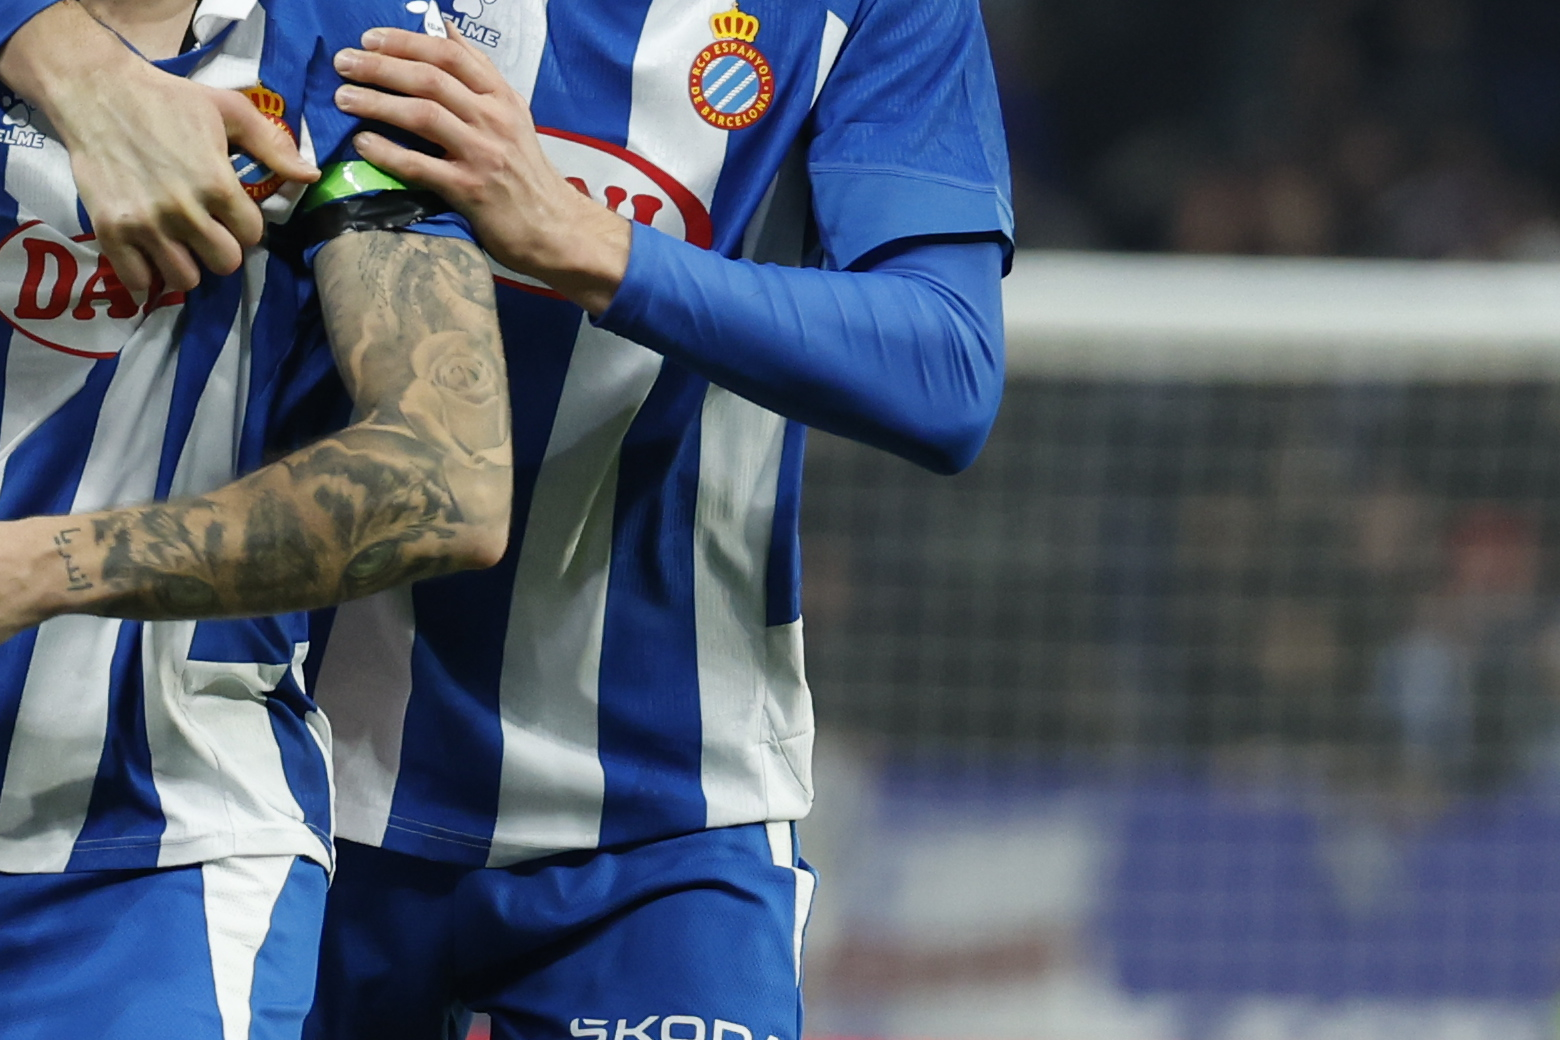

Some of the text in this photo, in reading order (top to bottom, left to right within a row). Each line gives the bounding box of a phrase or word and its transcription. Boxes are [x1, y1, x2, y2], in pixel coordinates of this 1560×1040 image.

[692, 42, 771, 83] RCD ESPANYOL
[691, 86, 771, 127] DE BARCELONA
[14, 237, 166, 321] DA
[570, 1015, 780, 1040] SKOD
